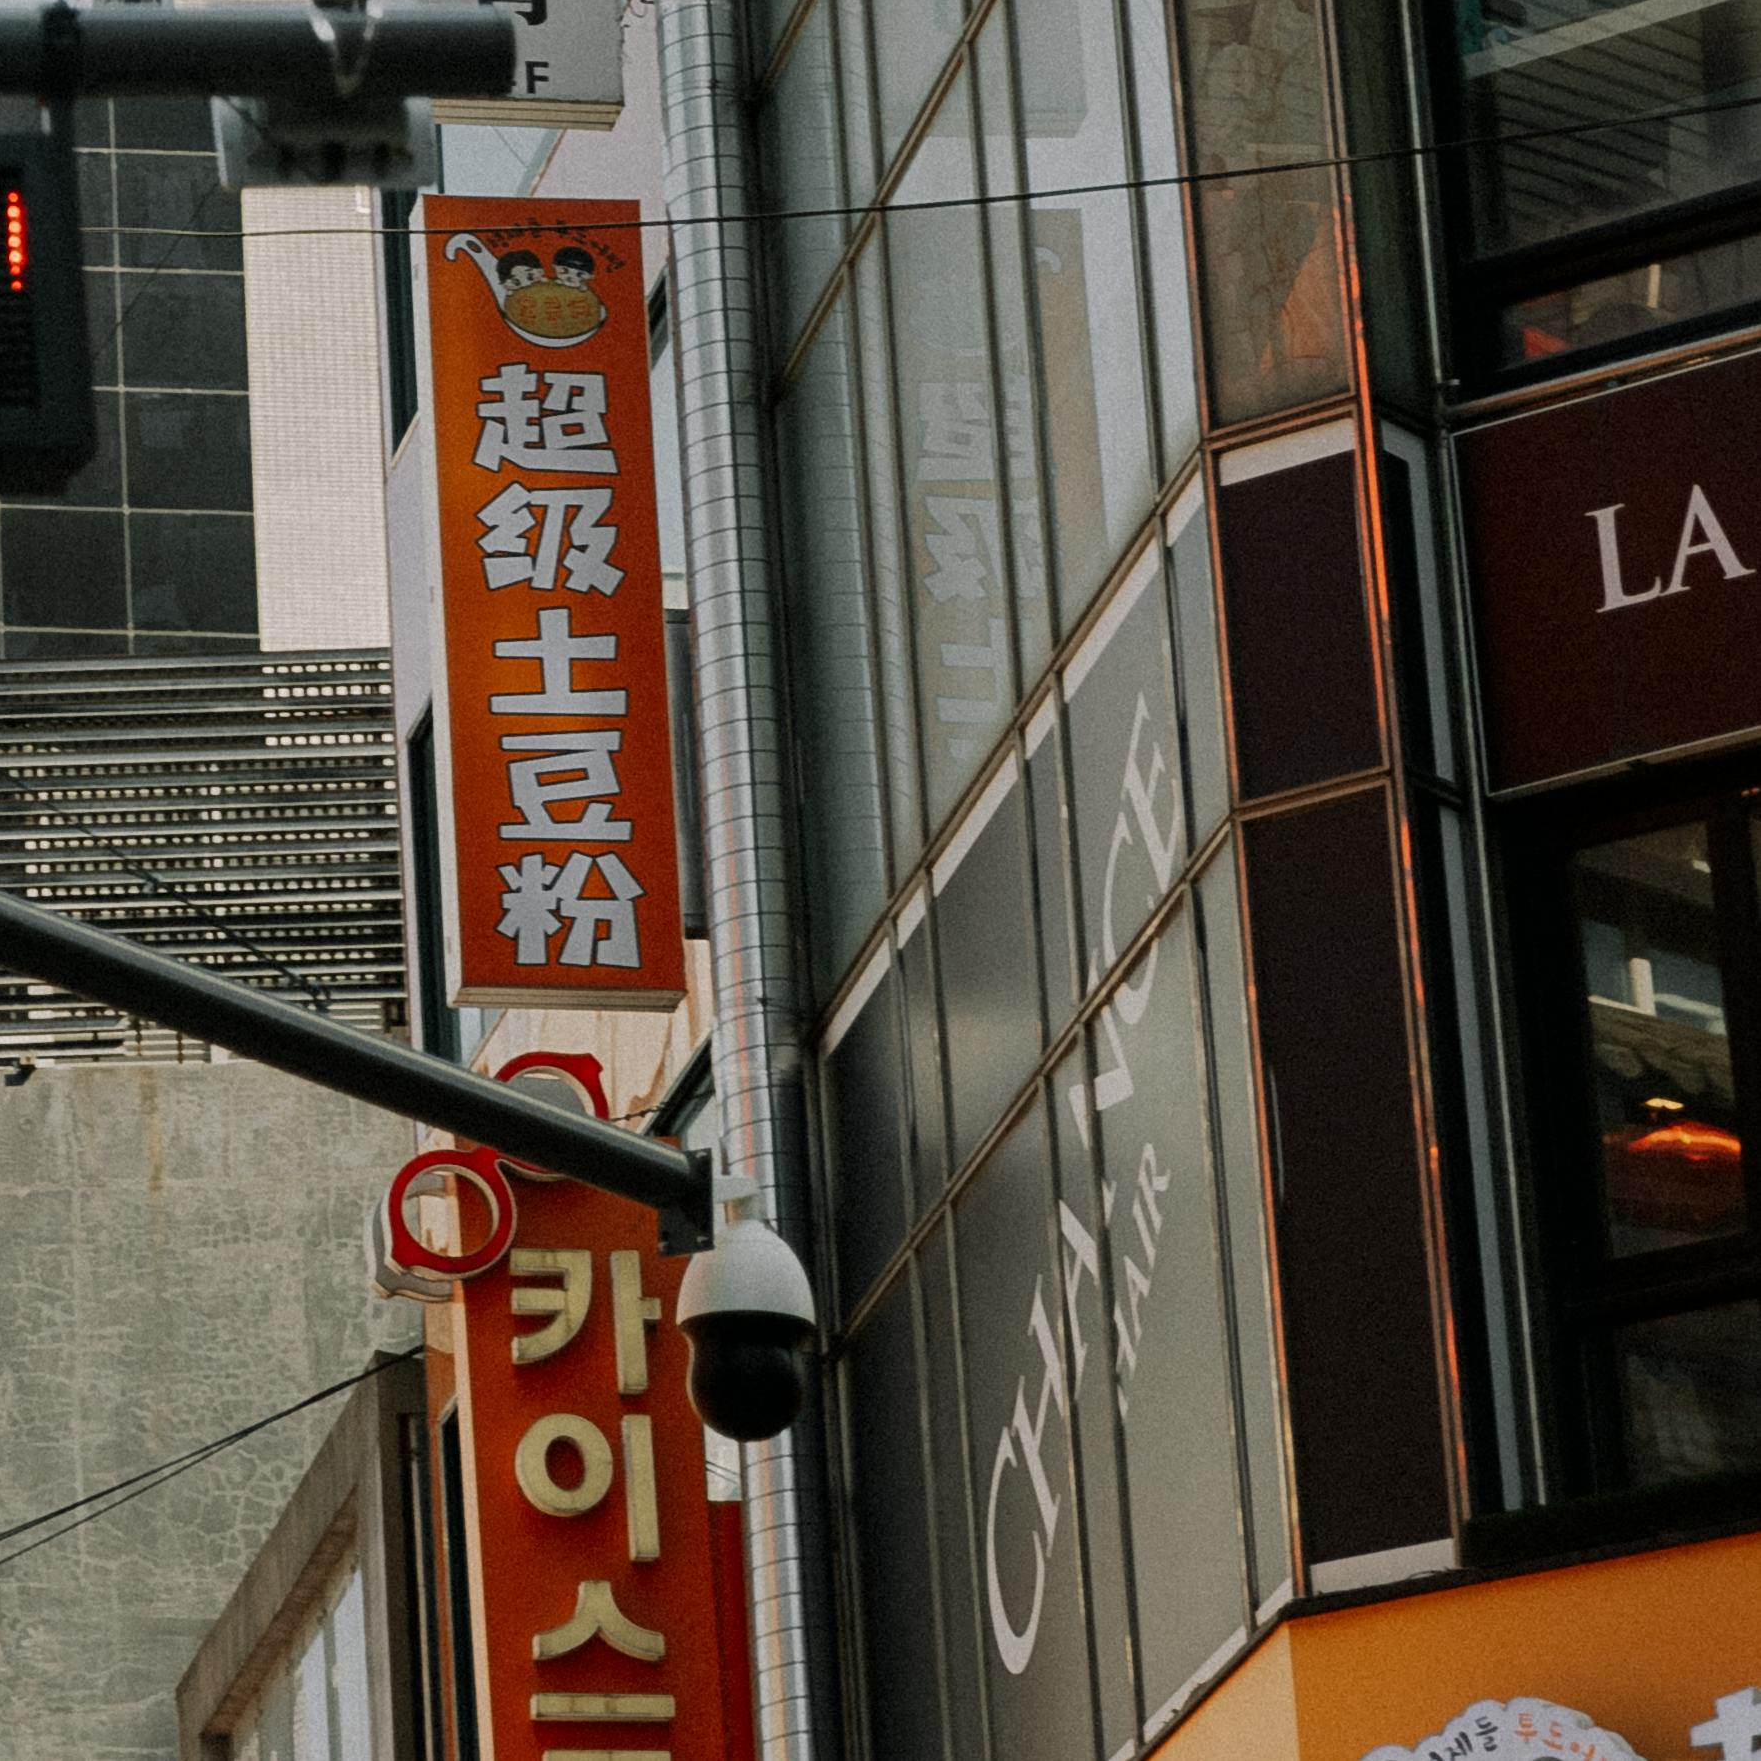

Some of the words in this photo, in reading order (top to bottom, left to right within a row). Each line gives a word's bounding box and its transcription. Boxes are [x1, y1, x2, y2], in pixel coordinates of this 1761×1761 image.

[474, 362, 646, 970] 超级土豆粉
[1584, 483, 1756, 614] LA
[510, 1248, 676, 1761] 카이스
